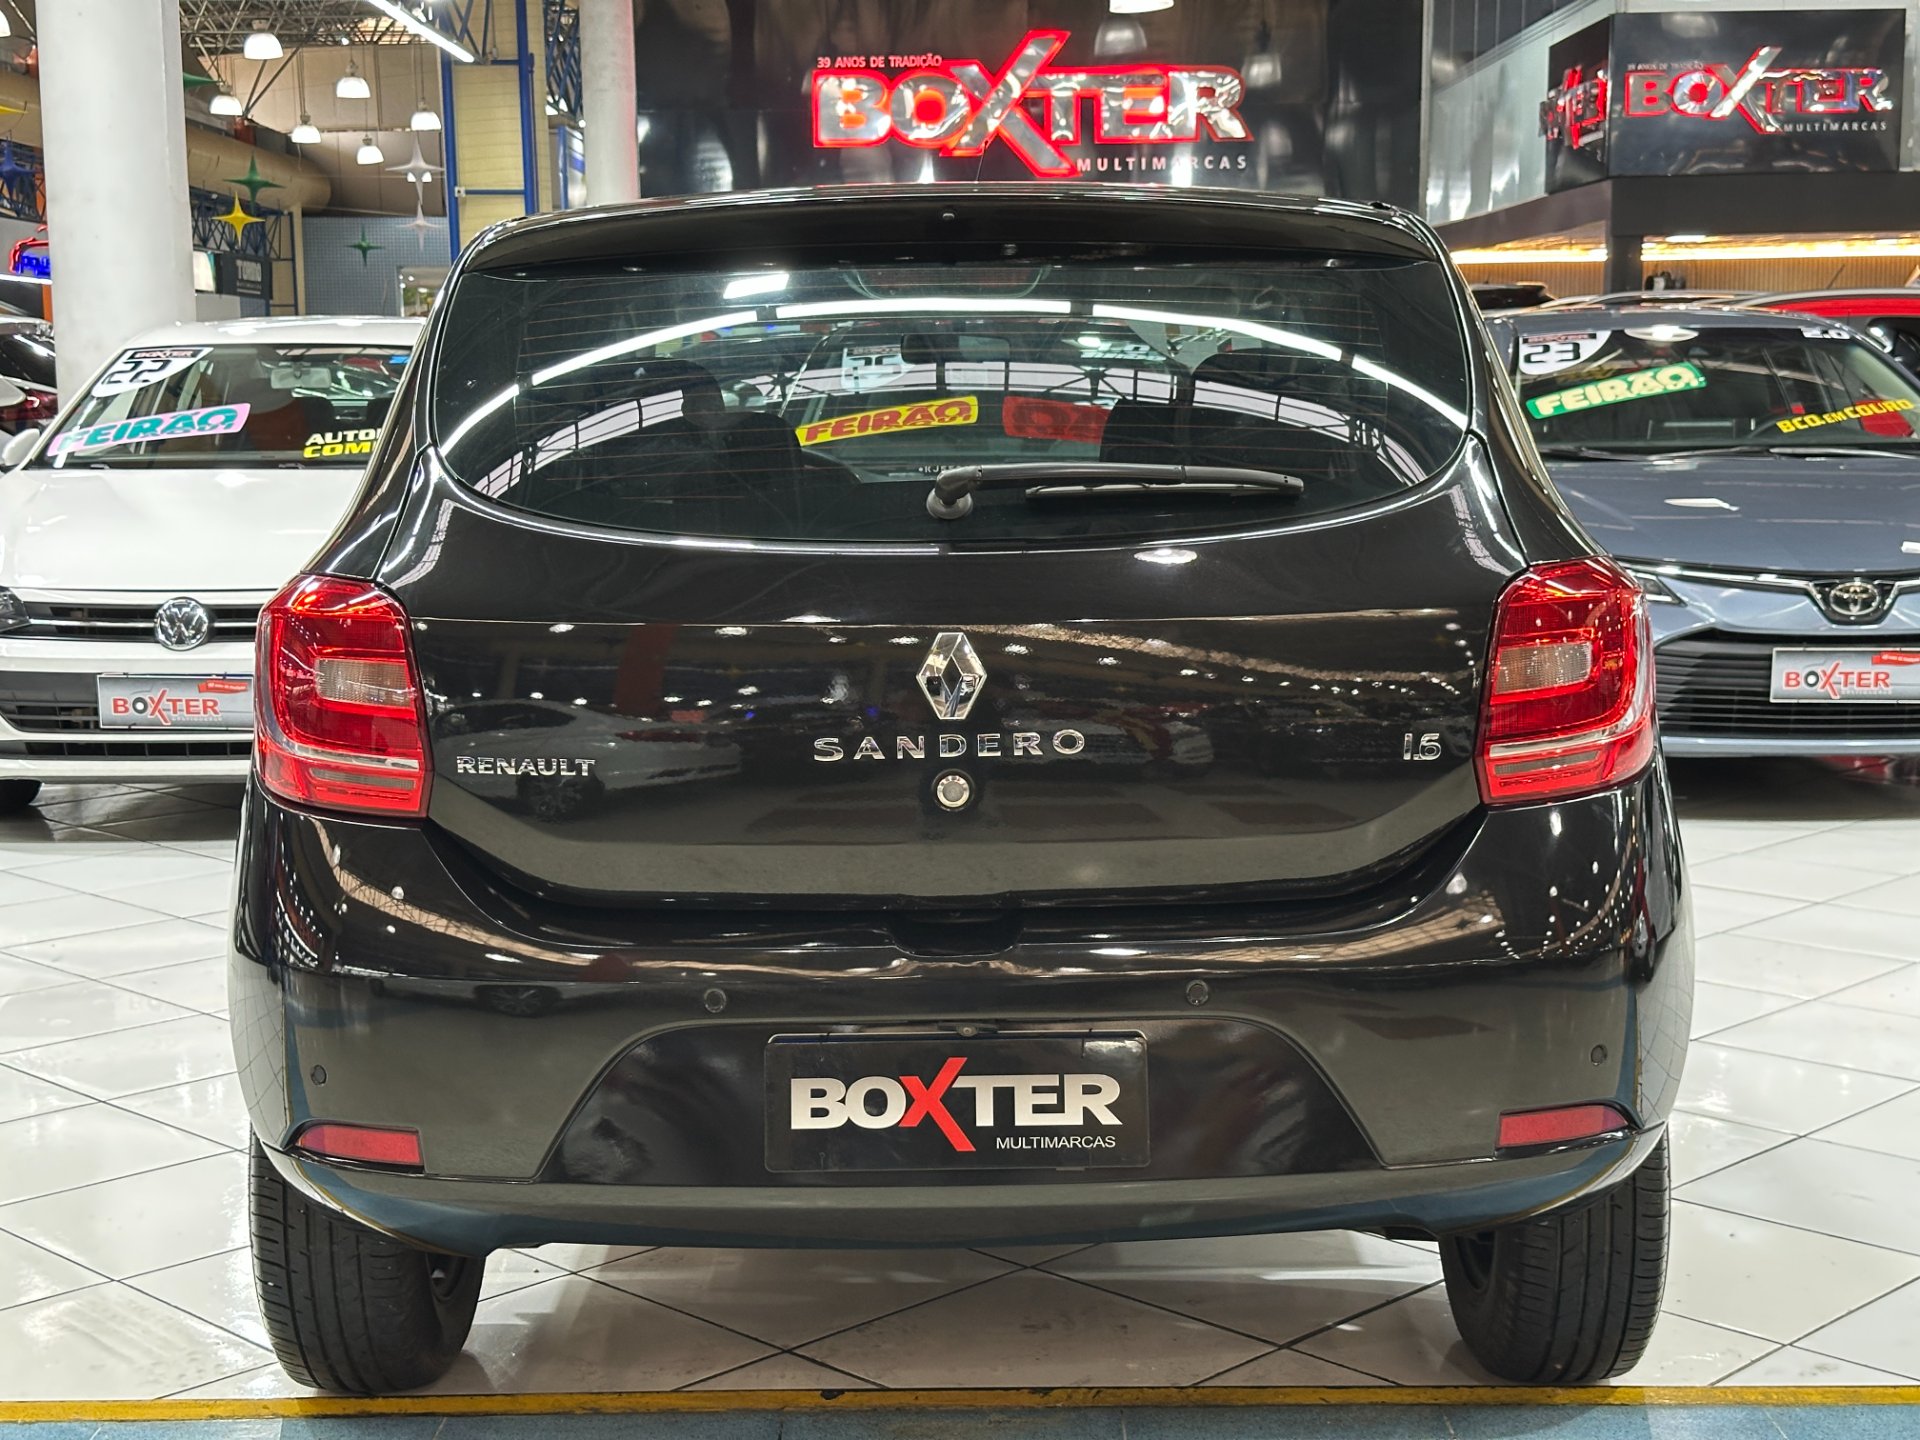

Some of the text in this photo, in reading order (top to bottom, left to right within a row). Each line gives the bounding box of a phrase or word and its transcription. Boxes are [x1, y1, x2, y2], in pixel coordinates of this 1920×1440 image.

[817, 53, 942, 68] 39 ANOS DE TRADIÇÃO
[812, 30, 1254, 177] BOXTER
[1624, 45, 1893, 134] BOXTER
[1783, 120, 1887, 132] MULTIMARCAS
[1077, 155, 1247, 171] MULTIMARCAS
[1523, 342, 1581, 364] 23
[101, 360, 172, 385] 22
[1535, 365, 1698, 416] FEIRÃO
[805, 400, 972, 442] FEIRÃO
[1844, 399, 1914, 418] COURO
[58, 407, 238, 451] FEIRÃO
[303, 441, 376, 458] COM
[1783, 660, 1892, 699] BOXTER
[112, 688, 221, 725] BOXTER
[814, 728, 1085, 762] SANDERO
[456, 756, 596, 776] RENAULT
[791, 1057, 1123, 1152] BOXTER
[996, 1136, 1116, 1150] MULTIMARCAS
